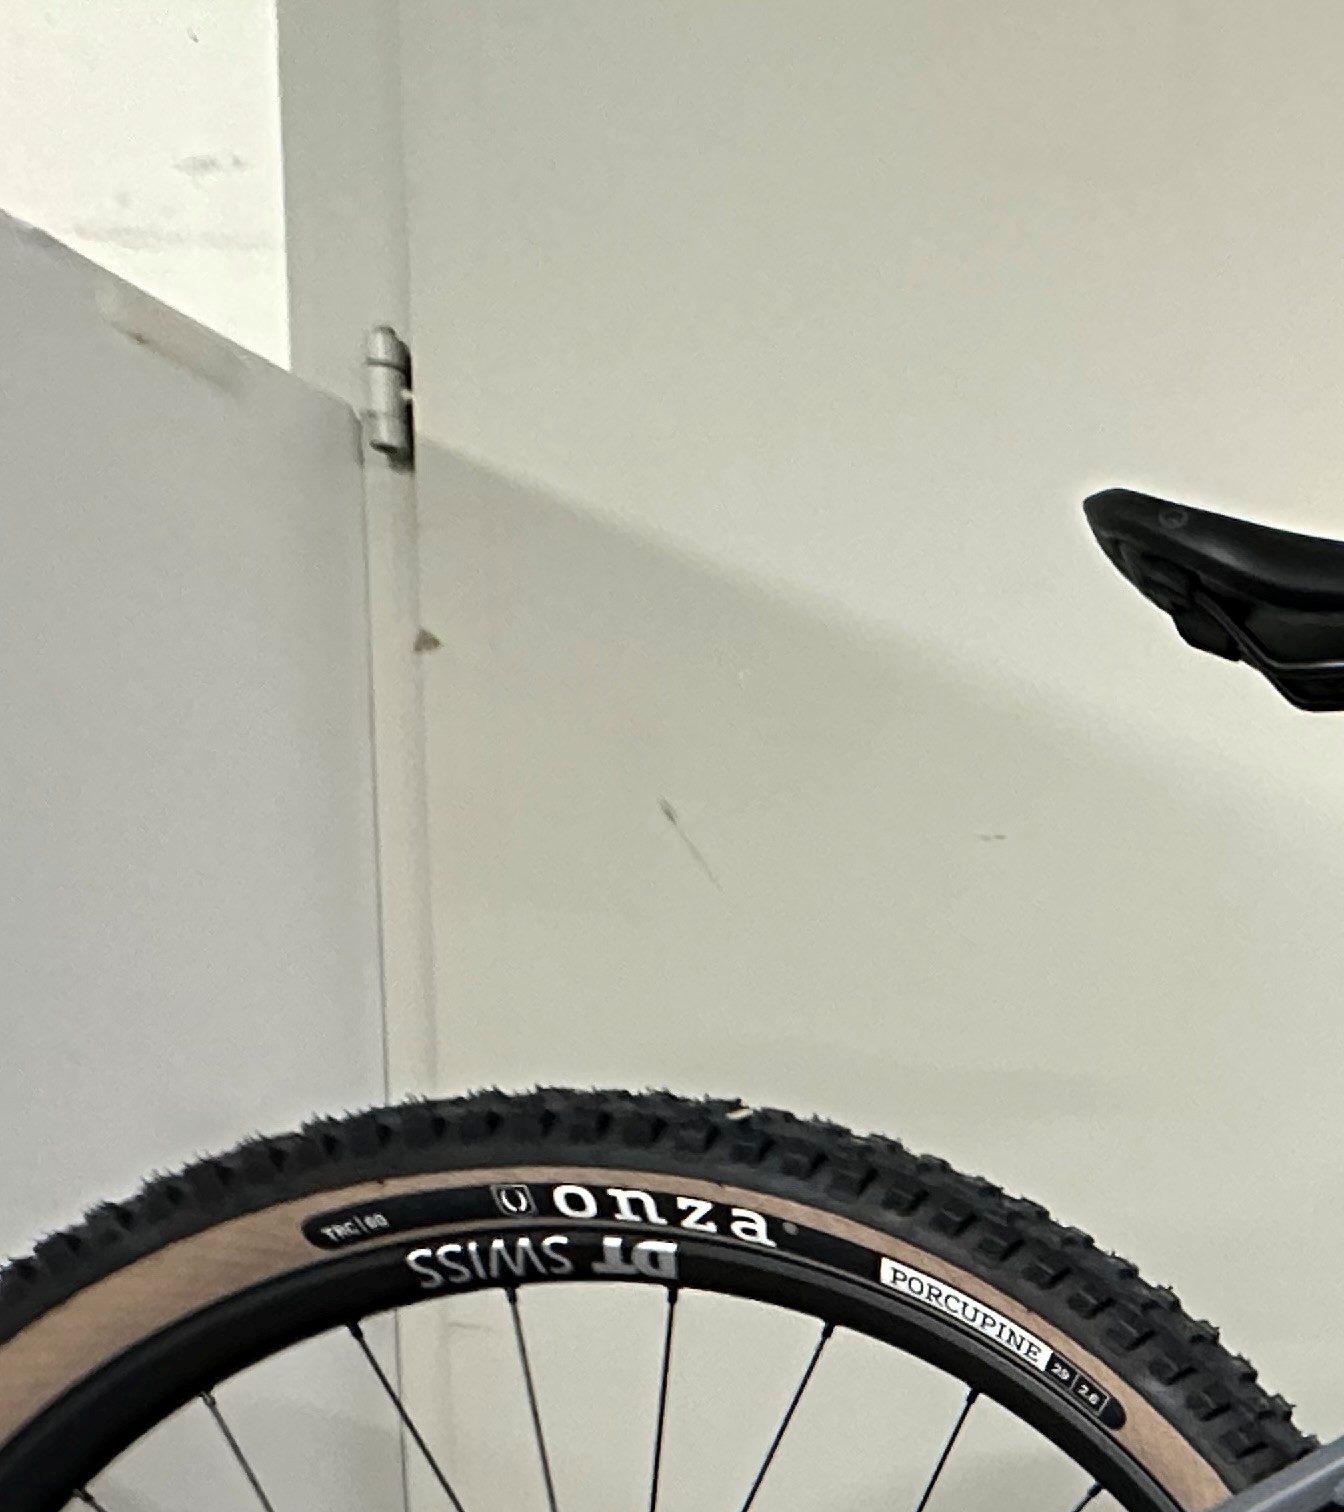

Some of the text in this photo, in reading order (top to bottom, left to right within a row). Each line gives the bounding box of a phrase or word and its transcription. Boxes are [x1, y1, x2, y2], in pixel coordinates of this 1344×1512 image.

[552, 1184, 776, 1248] onza
[405, 1235, 679, 1289] DT SWISS
[890, 1266, 1042, 1363] PORCUPINE
